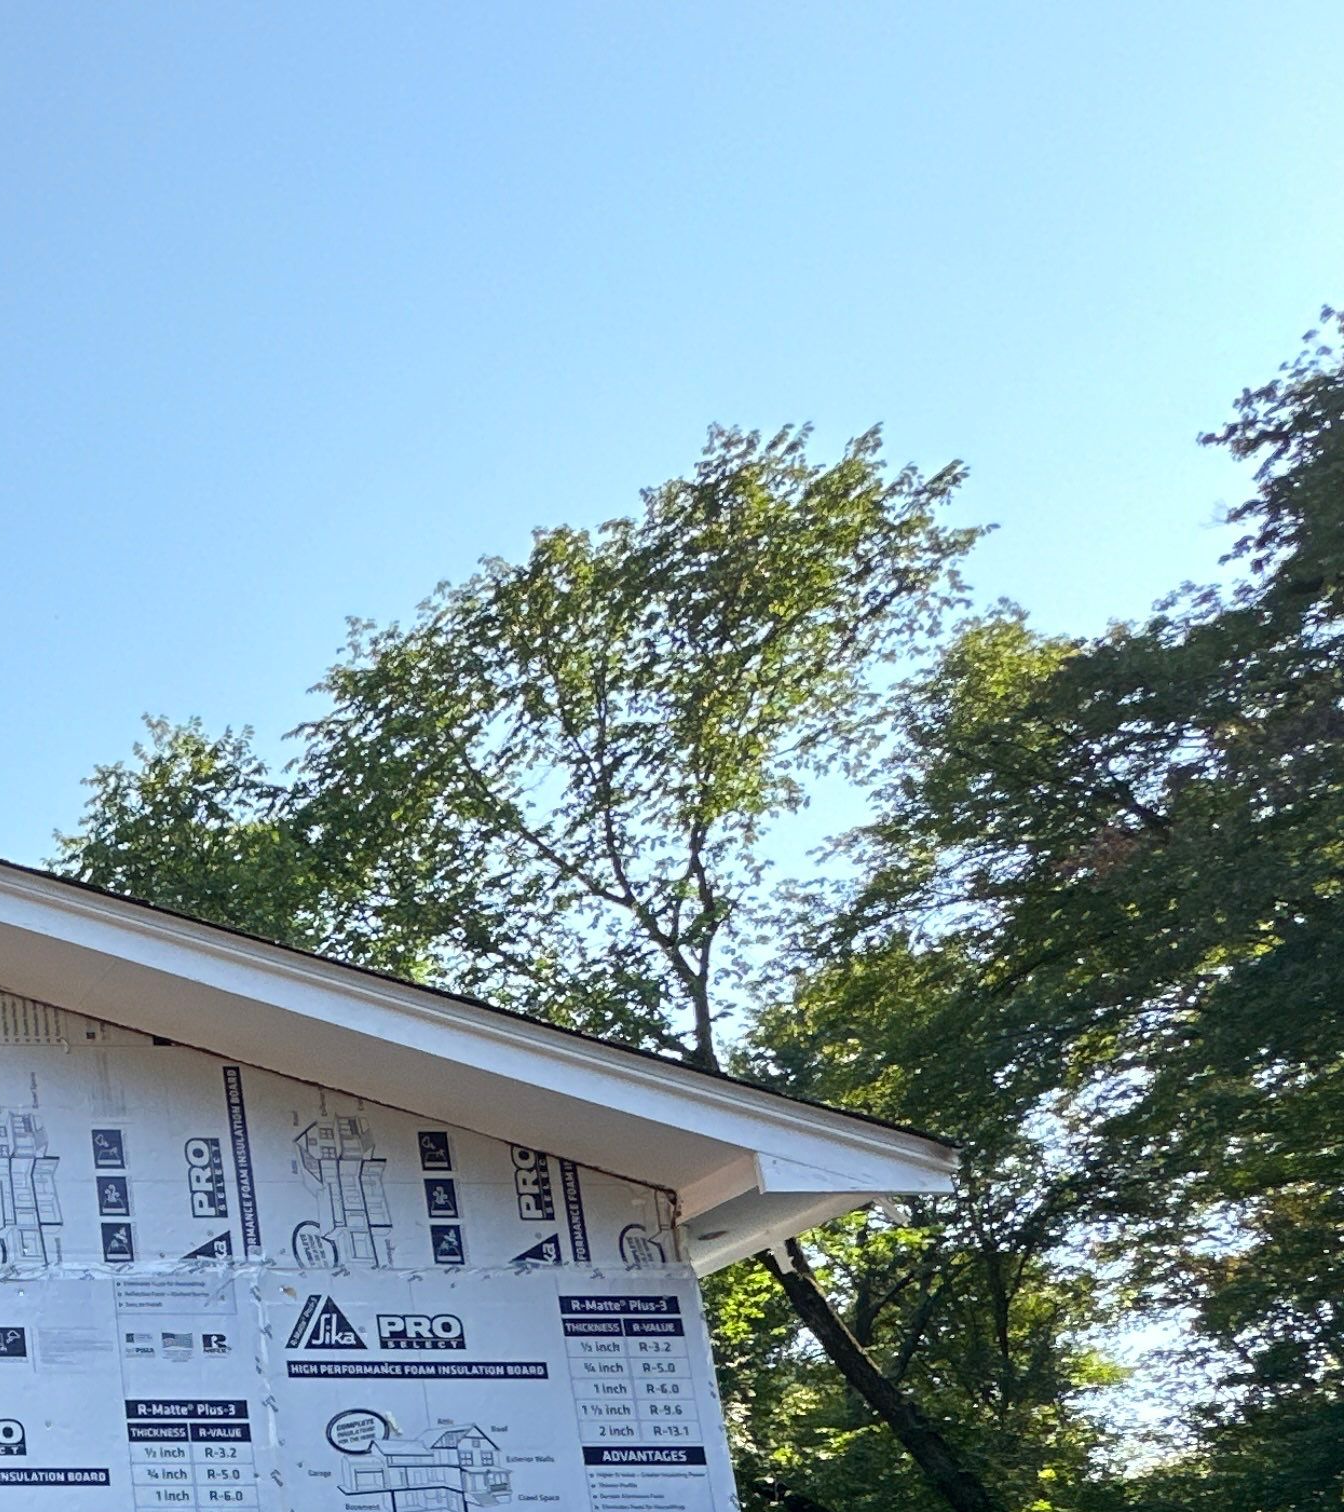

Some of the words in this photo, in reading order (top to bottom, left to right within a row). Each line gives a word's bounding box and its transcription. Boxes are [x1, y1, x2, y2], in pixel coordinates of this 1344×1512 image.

[312, 1313, 356, 1345] Sika
[379, 1316, 461, 1338] PRO
[388, 1340, 457, 1348] SELECT
[196, 1403, 236, 1415] Plus-3
[600, 1426, 606, 1436] 2
[609, 1425, 634, 1436] inch
[653, 1426, 689, 1436] R-13.1
[67, 1472, 106, 1482] BOARD
